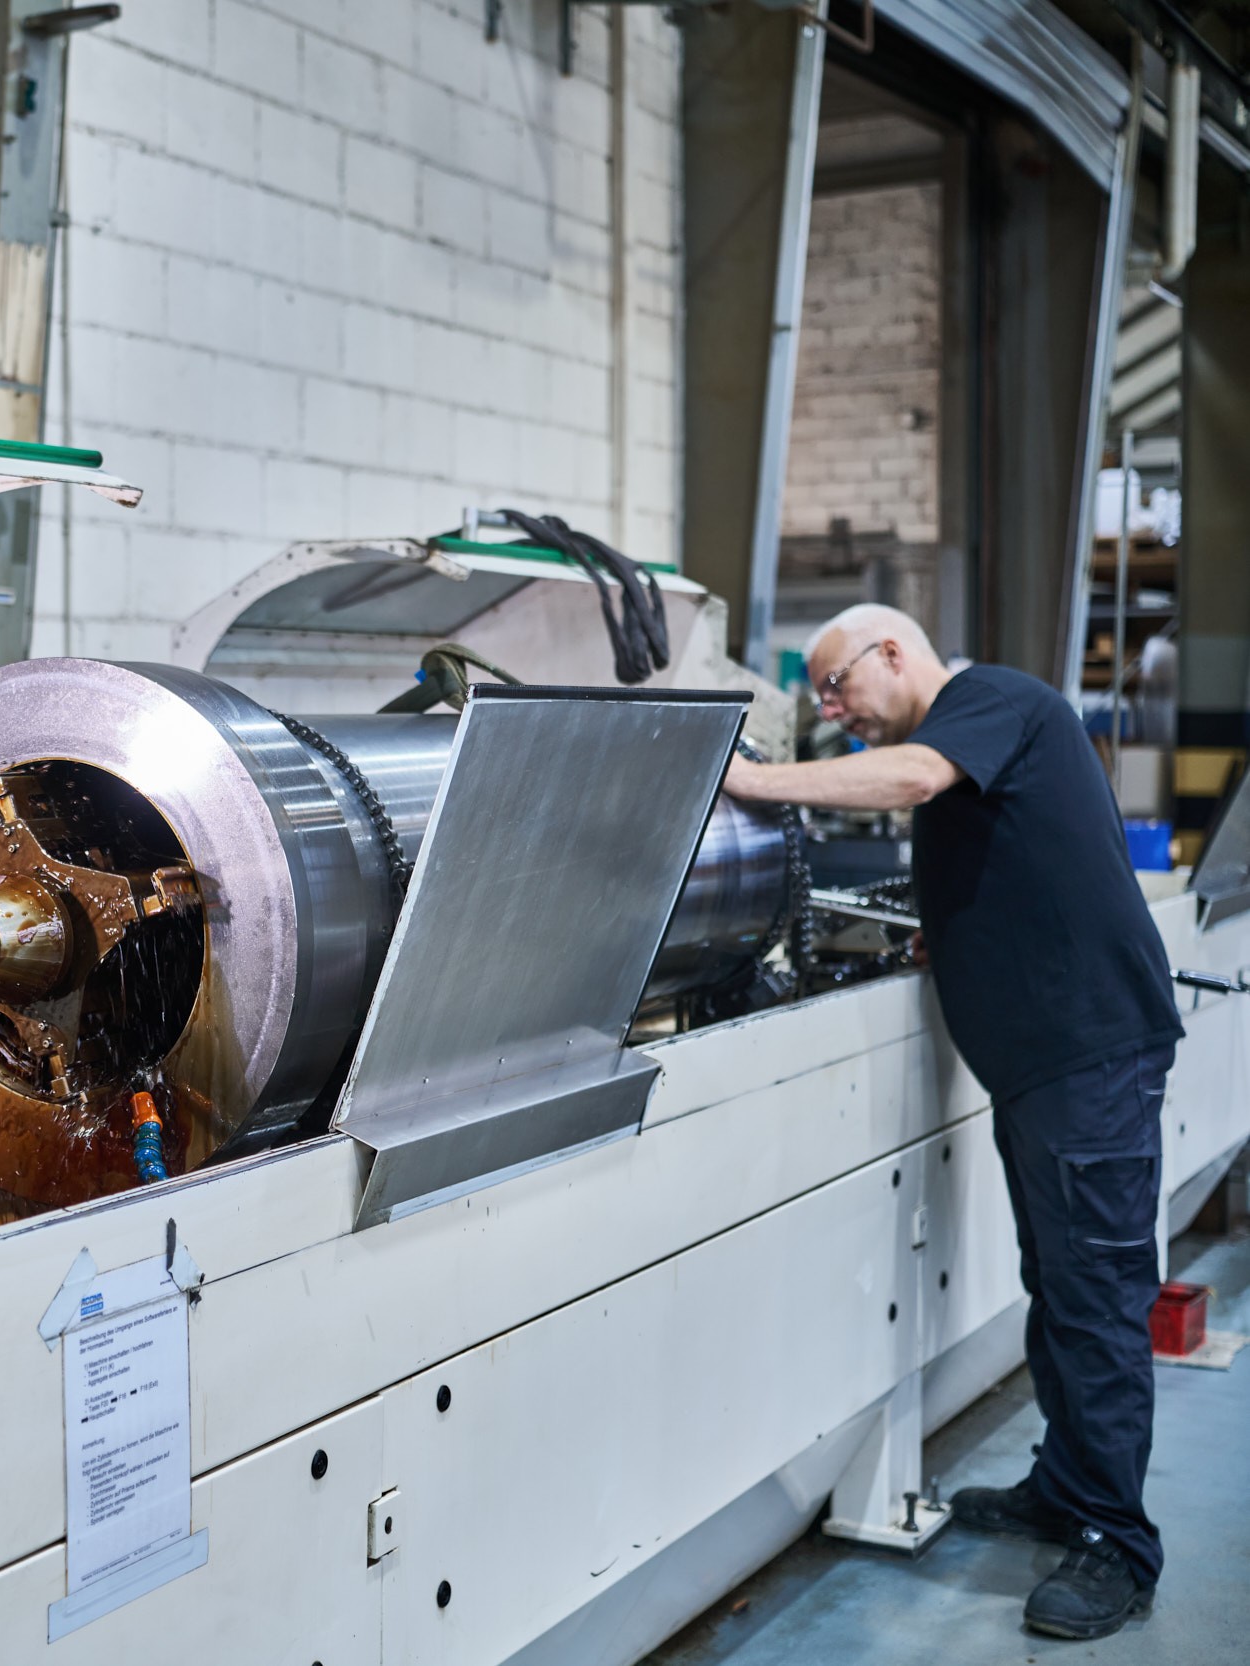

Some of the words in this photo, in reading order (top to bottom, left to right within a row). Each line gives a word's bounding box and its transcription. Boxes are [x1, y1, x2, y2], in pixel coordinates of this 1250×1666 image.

[79, 1332, 106, 1346] Beschreibung
[115, 1322, 133, 1333] Umgangs
[144, 1308, 172, 1322] Softwarefehlers
[87, 1338, 114, 1351] Honmaschine
[88, 1358, 108, 1368] Maschine
[108, 1349, 130, 1361] einschalten
[132, 1340, 153, 1352] hochfahren
[88, 1369, 99, 1377] Taste
[99, 1365, 107, 1373] F11
[88, 1375, 108, 1387] Aggregate
[108, 1366, 130, 1378] einschalten
[90, 1390, 114, 1403] Ausschalten
[89, 1404, 100, 1412] Taste
[89, 1407, 116, 1421] Hauptschalter
[97, 1448, 120, 1462] Zylinderrohr
[154, 1426, 172, 1437] Maschine
[82, 1468, 91, 1477] folgt
[90, 1471, 107, 1482] Messuhr
[107, 1463, 126, 1474] einstellen
[90, 1477, 112, 1490] Passenden
[112, 1469, 130, 1480] Honkopf
[129, 1464, 143, 1473] wählen
[146, 1455, 163, 1466] einstellen
[90, 1494, 114, 1509] Zylinderrohr
[121, 1484, 135, 1493] Prisma
[135, 1474, 157, 1488] aufspannen
[90, 1484, 116, 1500] Durchmesser
[90, 1502, 114, 1517] Zylinderrohr
[114, 1493, 135, 1506] vermessen
[90, 1514, 105, 1526] Spindel
[106, 1506, 125, 1518] verriegeln
